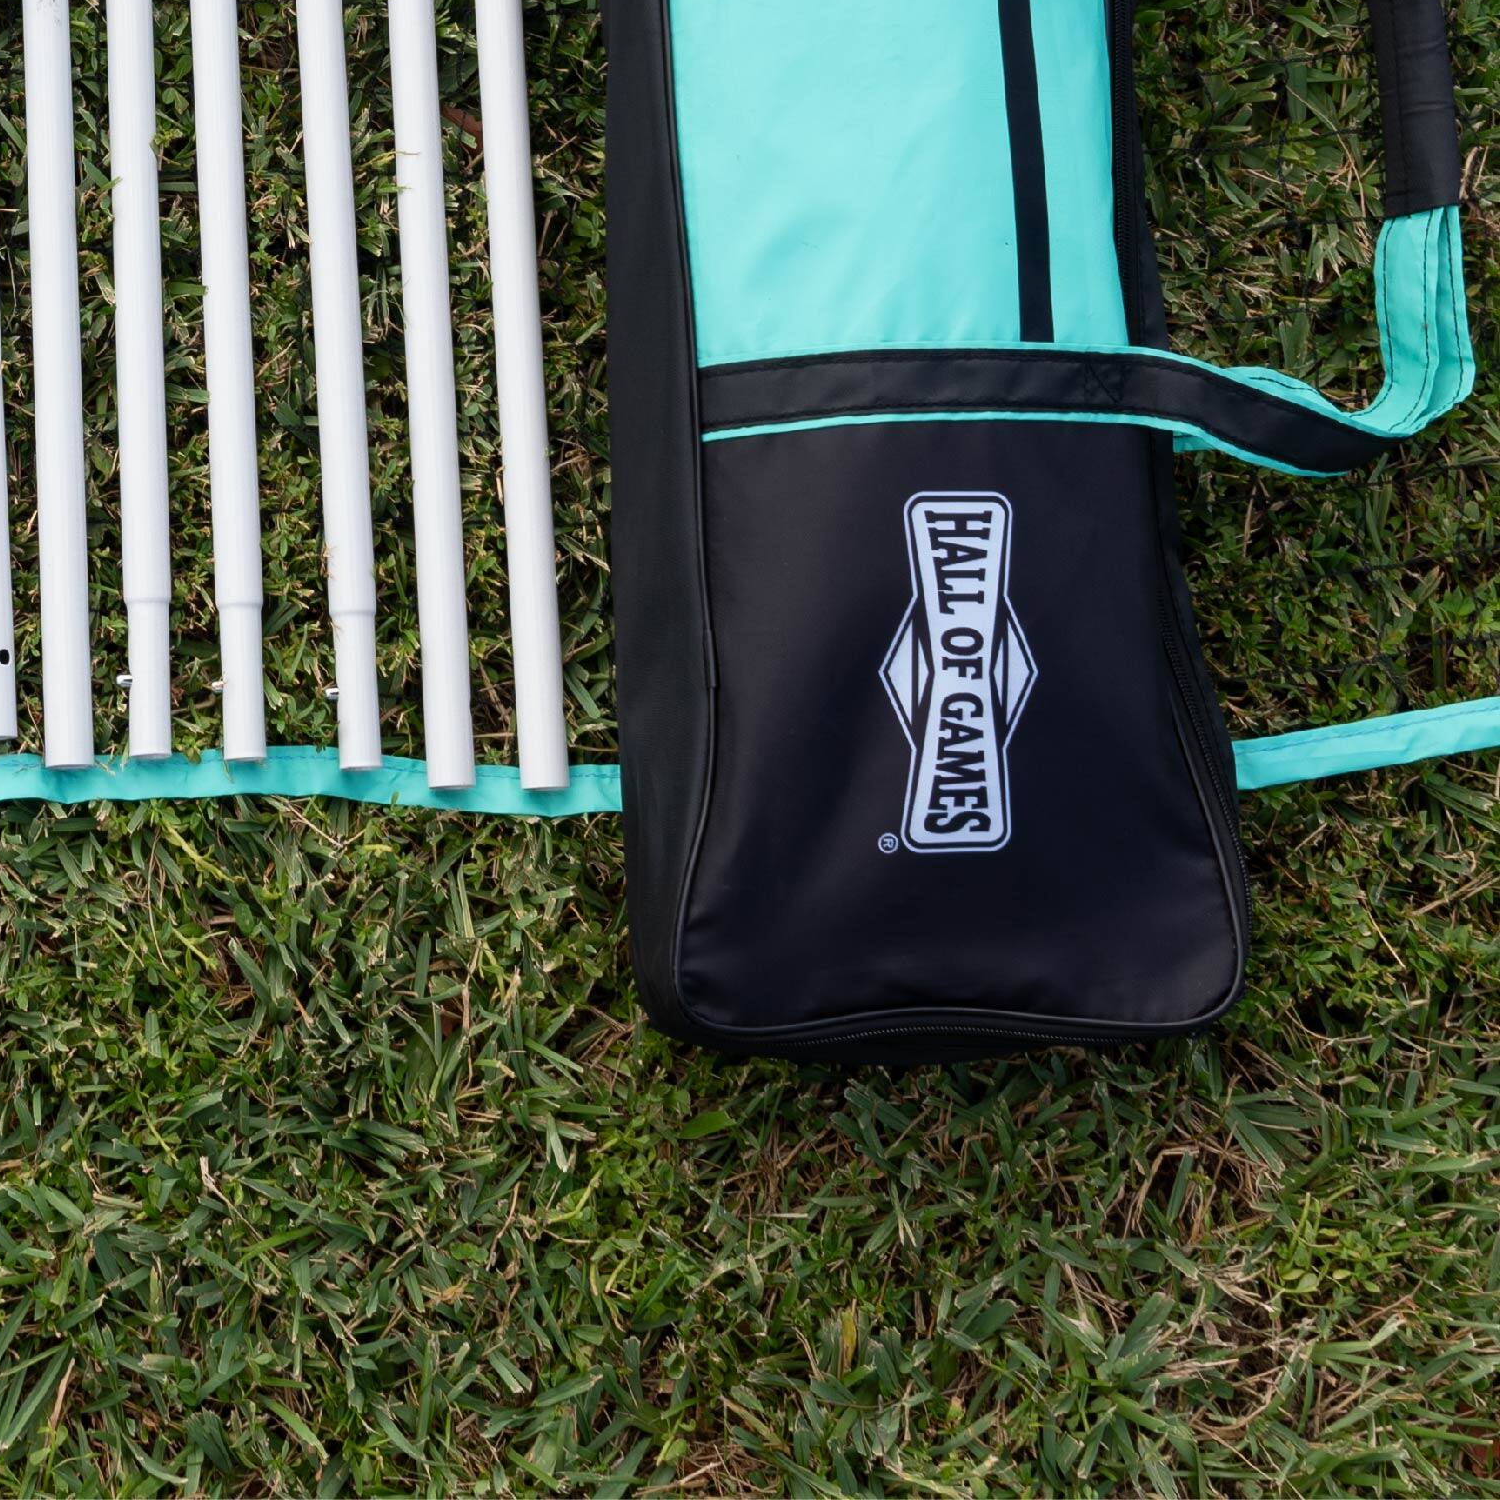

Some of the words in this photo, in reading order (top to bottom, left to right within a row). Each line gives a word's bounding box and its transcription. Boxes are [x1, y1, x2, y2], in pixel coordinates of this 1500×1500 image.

[924, 510, 992, 615] HALL
[940, 627, 985, 680] OF
[924, 692, 991, 834] GAMES
